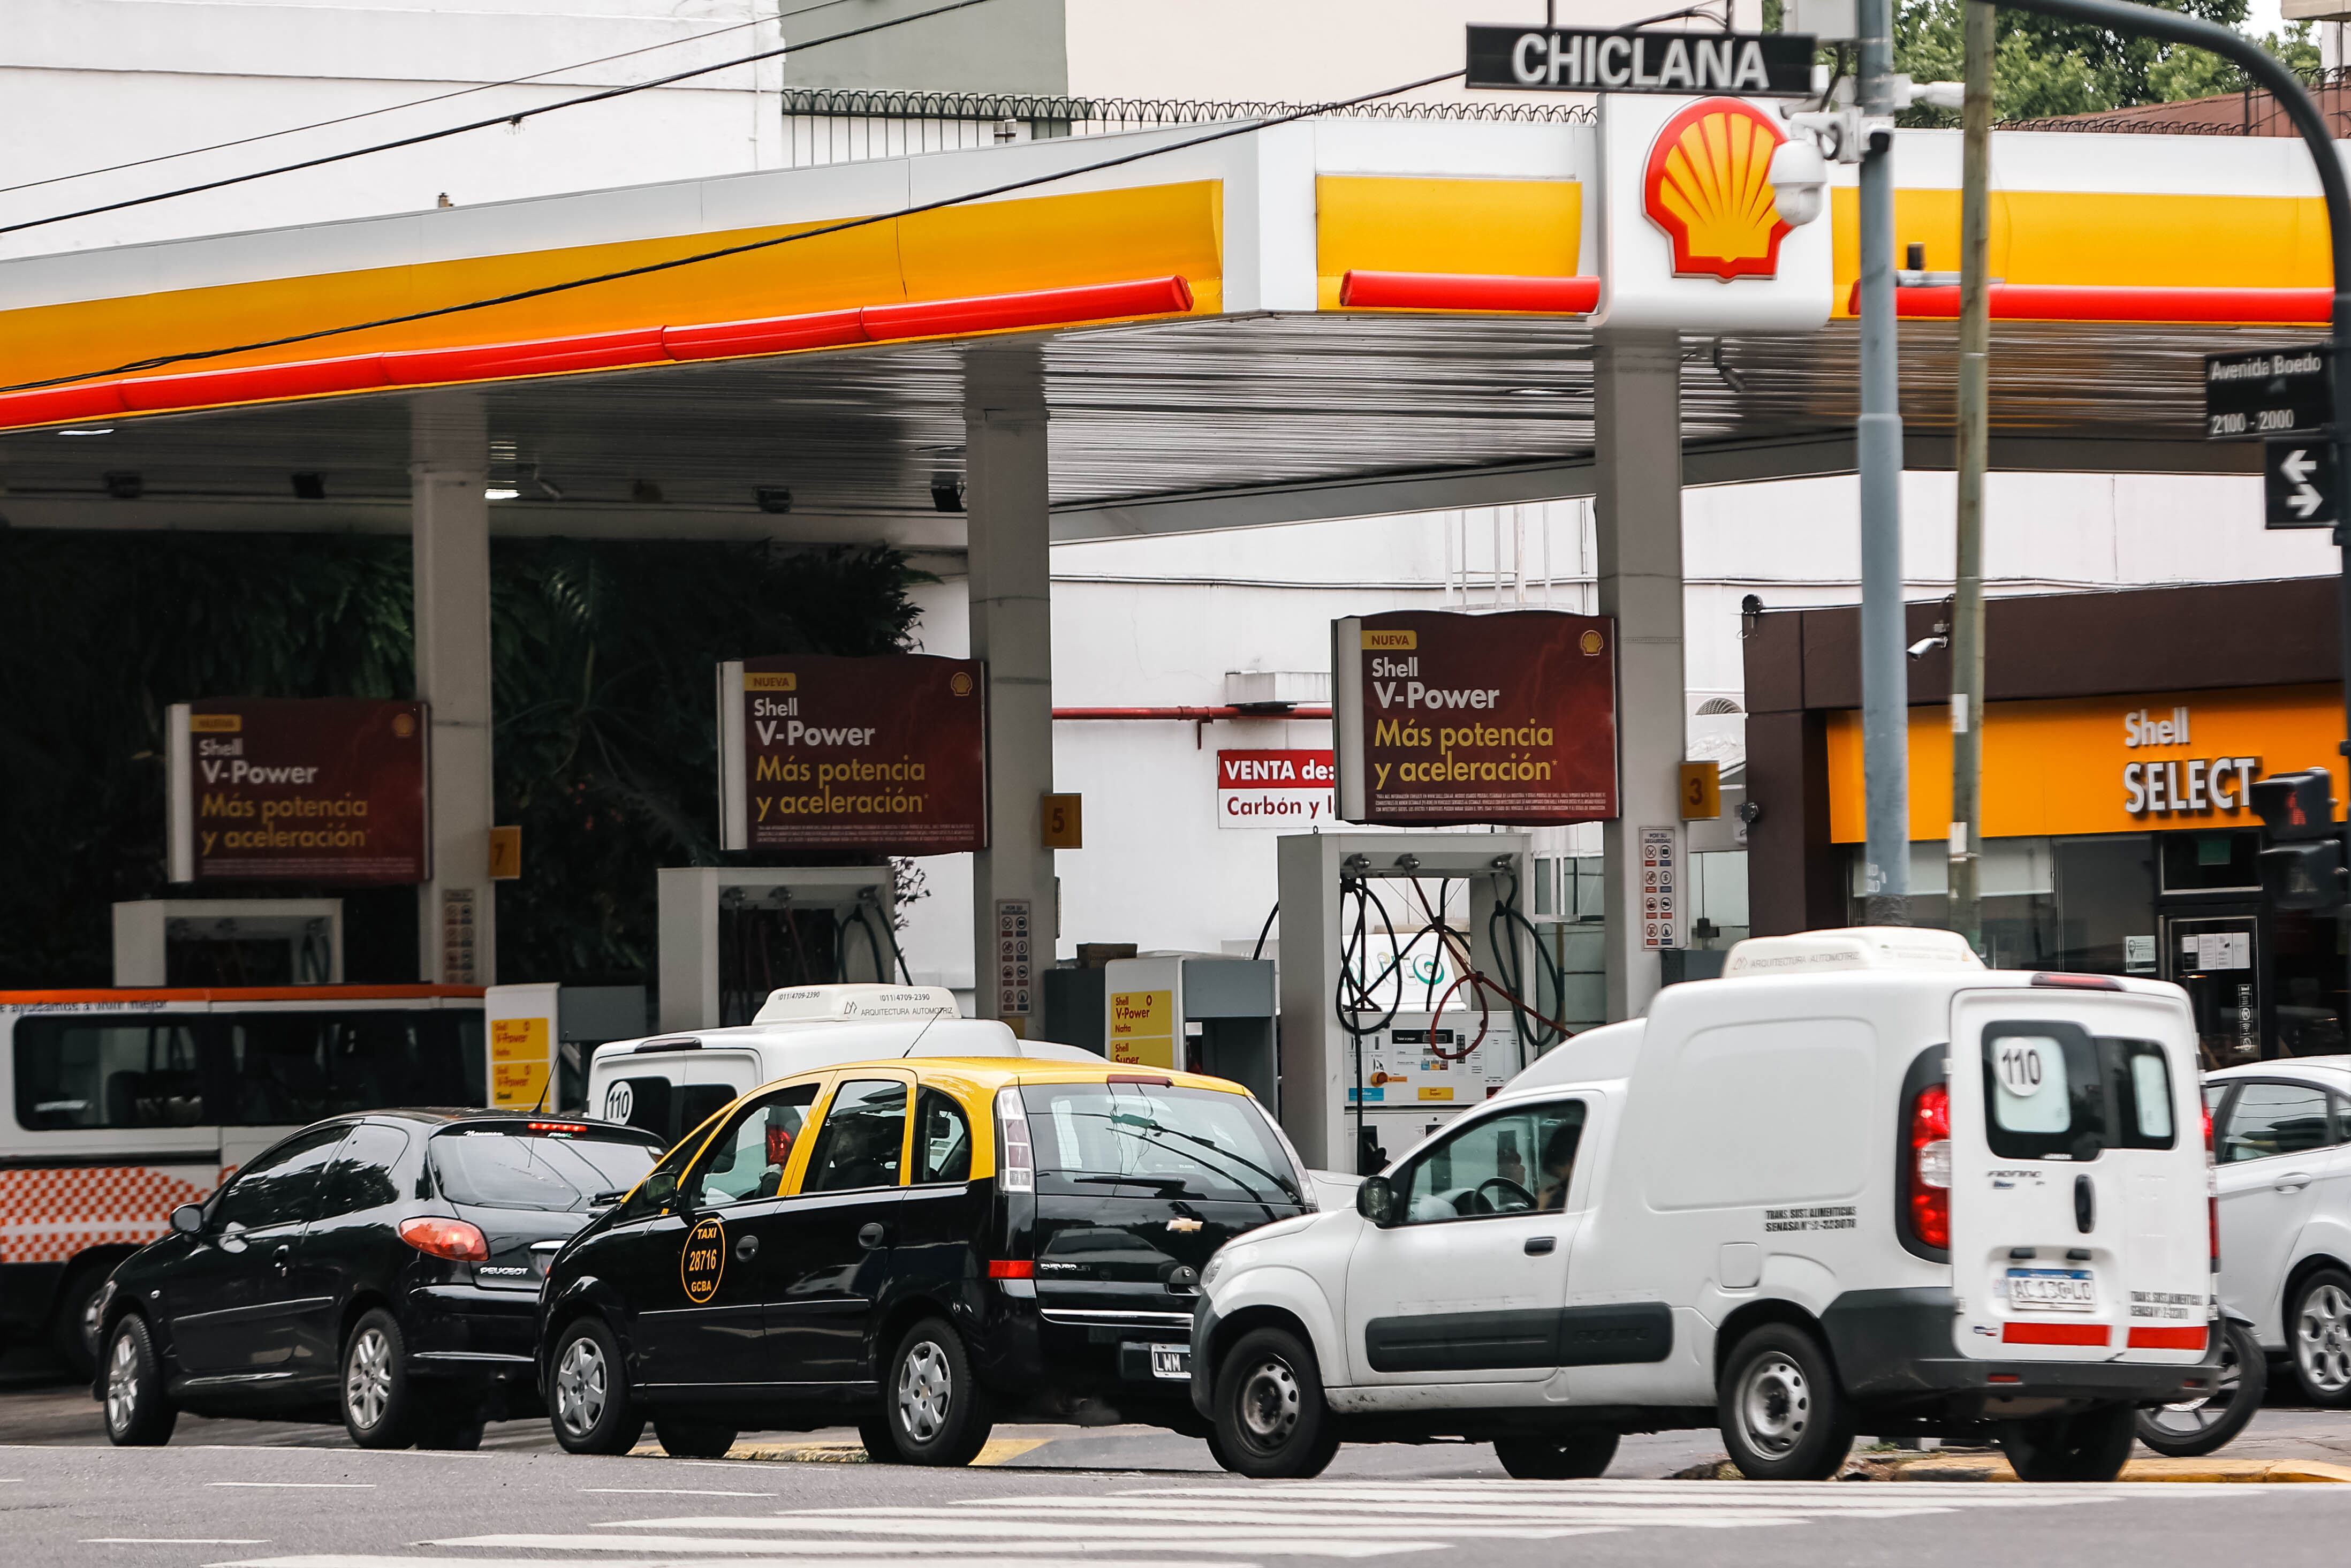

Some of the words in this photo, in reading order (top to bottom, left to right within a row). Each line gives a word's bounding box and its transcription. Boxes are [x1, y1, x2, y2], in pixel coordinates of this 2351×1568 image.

[1512, 32, 1770, 89] CHICLANA
[2211, 357, 2270, 380] Avenida
[2272, 352, 2322, 375] Boedo
[2211, 413, 2246, 434] 2100
[2257, 409, 2294, 430] 2000
[1371, 634, 1410, 646] NUEVA
[1372, 656, 1418, 677] Shell
[753, 677, 790, 686] NUEVA
[1374, 681, 1499, 709] V-Power
[754, 698, 798, 717] Shell
[755, 720, 876, 746] V-Power
[1375, 718, 1432, 747] Más
[1440, 718, 1553, 755] potencia
[2125, 706, 2189, 747] Shell
[199, 738, 243, 756] Shell
[201, 760, 320, 784] V-Power
[756, 755, 812, 781] Más
[818, 754, 926, 790] potencia
[1224, 760, 1296, 780] VENTA
[1301, 759, 1334, 781] de:
[1375, 762, 1392, 790] y
[1689, 778, 1703, 806] 3
[2124, 757, 2255, 813] SELECT
[201, 792, 256, 817] Más
[262, 792, 368, 824] potencia
[756, 796, 772, 822] y
[1227, 795, 1302, 816] Carbón
[1308, 801, 1320, 820] y
[1051, 813, 1065, 834] 5
[201, 831, 219, 856] y
[495, 843, 504, 865] 7
[1751, 956, 1806, 968] ARQUITECTURA
[1810, 951, 1860, 963] AUTOMOTRIZ
[861, 1008, 909, 1016] ARQUITECTURA
[912, 1006, 953, 1015] AUTOMOTRIZ
[1115, 996, 1129, 1006] Shell
[1116, 1007, 1150, 1019] V-Power
[1115, 1023, 1131, 1033] Nafta
[1115, 1043, 1129, 1052] Shell
[2002, 1048, 2041, 1085] 110
[609, 1090, 630, 1119] 110
[697, 1226, 717, 1240] TAXI
[1766, 1221, 1800, 1232] SENASA
[480, 1267, 529, 1275] PEUGEOT
[689, 1249, 717, 1271] 28716
[691, 1280, 711, 1292] GCBA
